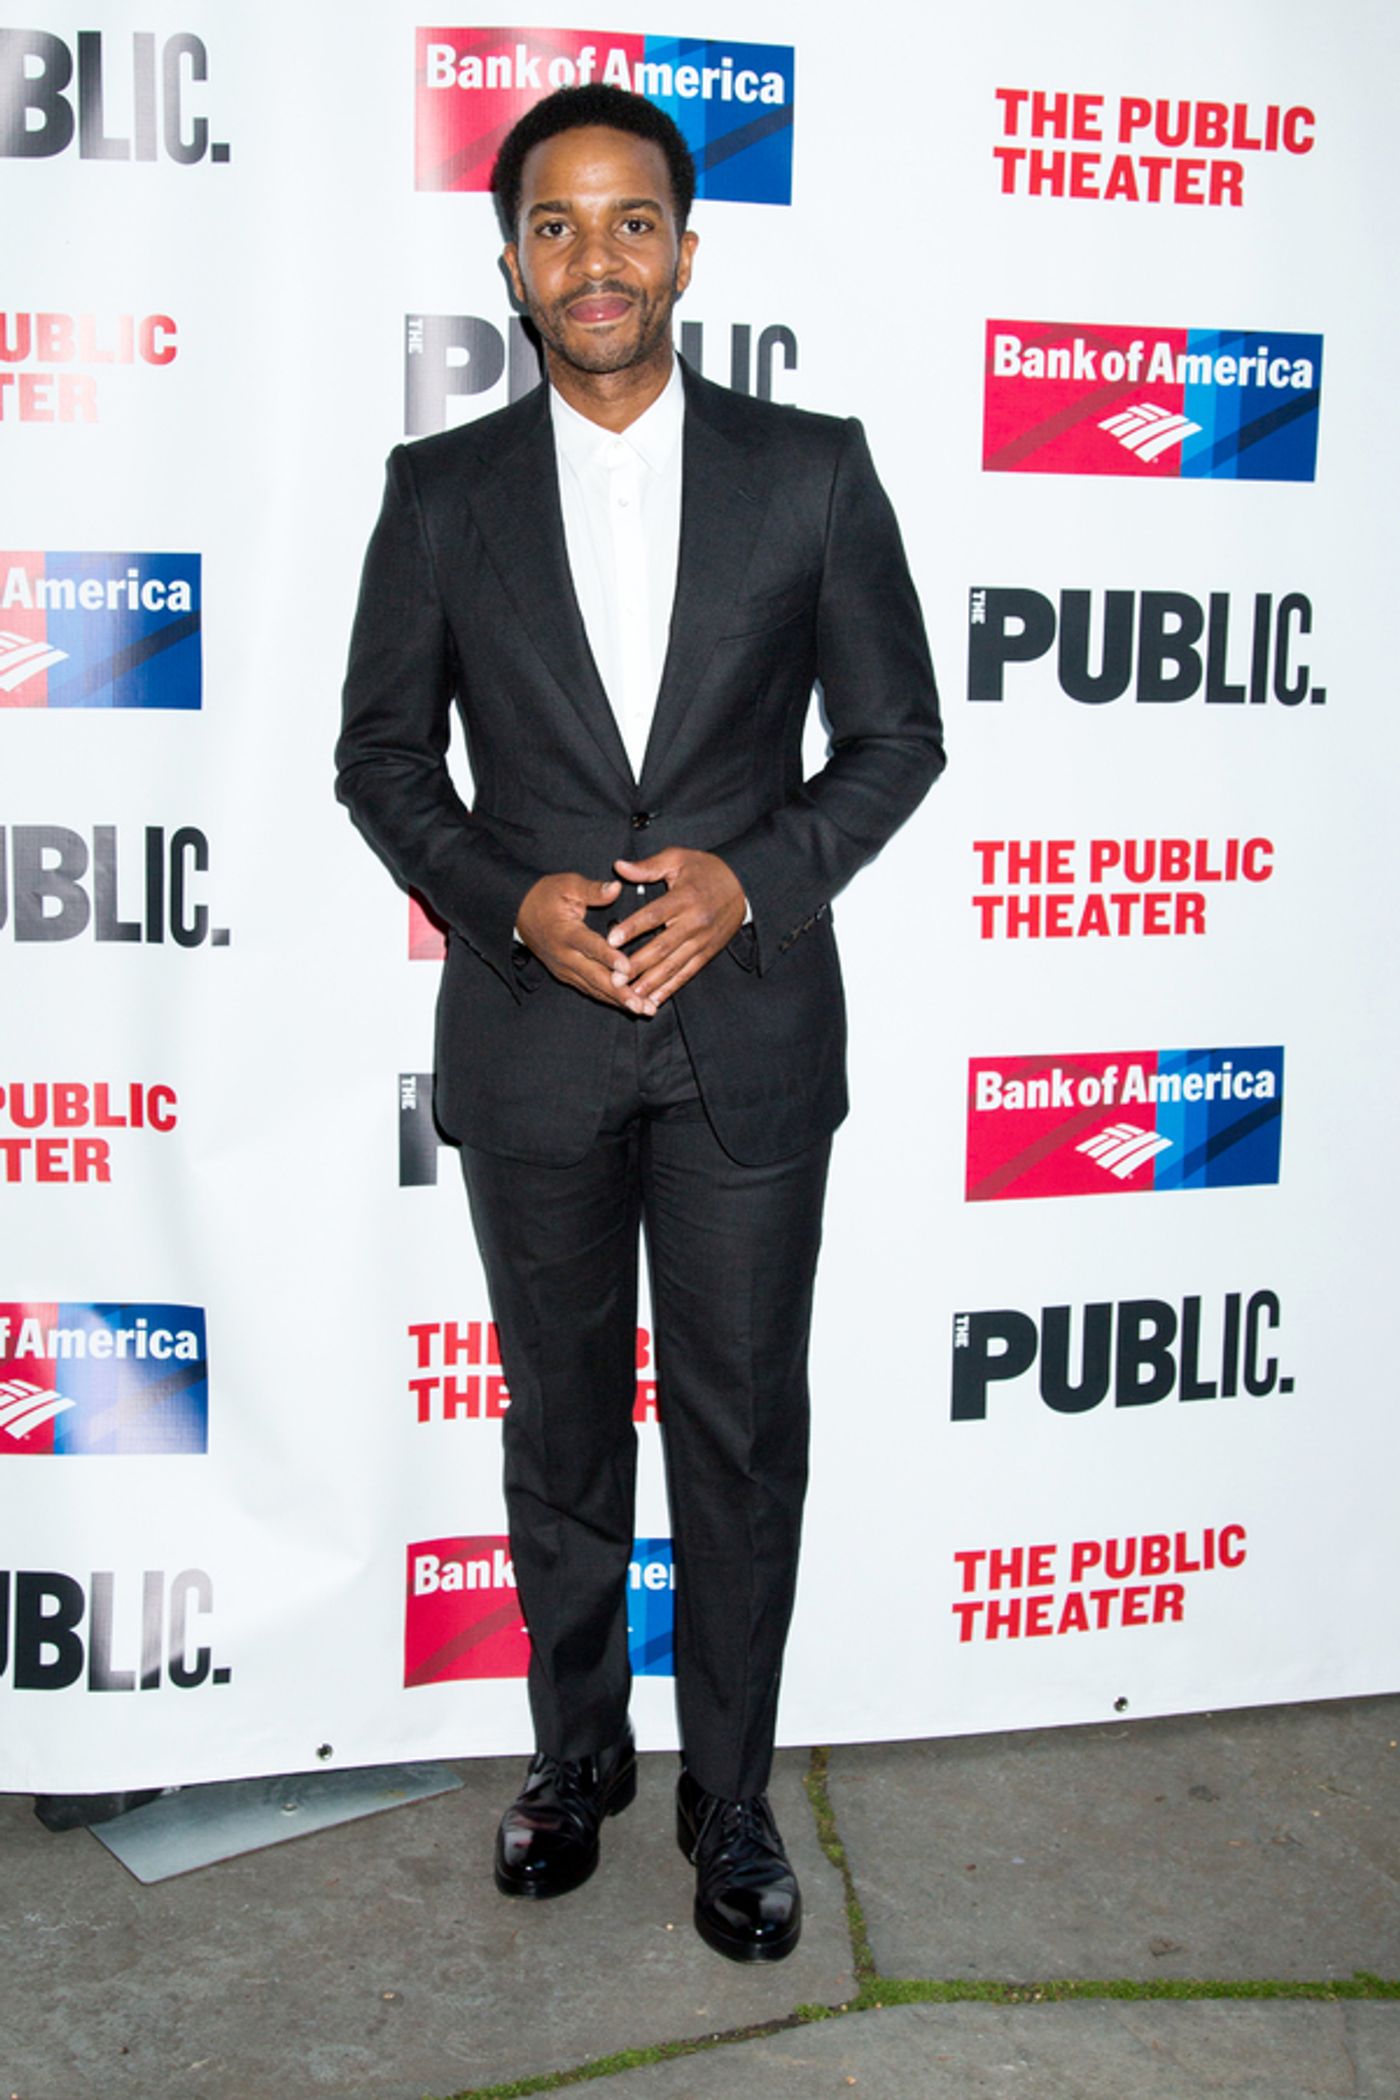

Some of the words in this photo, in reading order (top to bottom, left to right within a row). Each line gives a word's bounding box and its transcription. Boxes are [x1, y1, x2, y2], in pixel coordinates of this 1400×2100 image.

[426, 44, 542, 89] Bank
[548, 46, 596, 88] of
[602, 48, 785, 104] America
[996, 87, 1104, 142] THE
[1118, 96, 1316, 155] PUBLIC
[993, 146, 1244, 207] THEATER
[993, 335, 1097, 381] Bank
[1101, 341, 1144, 382] of
[1146, 342, 1313, 389] America
[2, 567, 191, 612] America
[971, 590, 986, 625] THE
[967, 586, 1327, 706] PUBLIC.
[973, 840, 1075, 885] THE
[1090, 837, 1274, 884] PUBLIC
[0, 825, 230, 948] BLIC.
[972, 892, 1206, 939] THEATER
[0, 1083, 177, 1132] UBLIC
[401, 1076, 416, 1110] THE
[975, 1068, 1074, 1111] Bank
[1078, 1065, 1119, 1106] of
[1121, 1062, 1275, 1104] America
[0, 1138, 112, 1183] TER
[14, 1318, 198, 1360] America
[950, 1289, 1294, 1421] PUBLIC.
[954, 1315, 969, 1348] THE
[414, 1550, 517, 1596] Bank
[954, 1544, 1057, 1593] THE
[1070, 1524, 1247, 1583] PUBLIC
[0, 1568, 232, 1692] BLIC.
[952, 1583, 1185, 1643] THEATER
